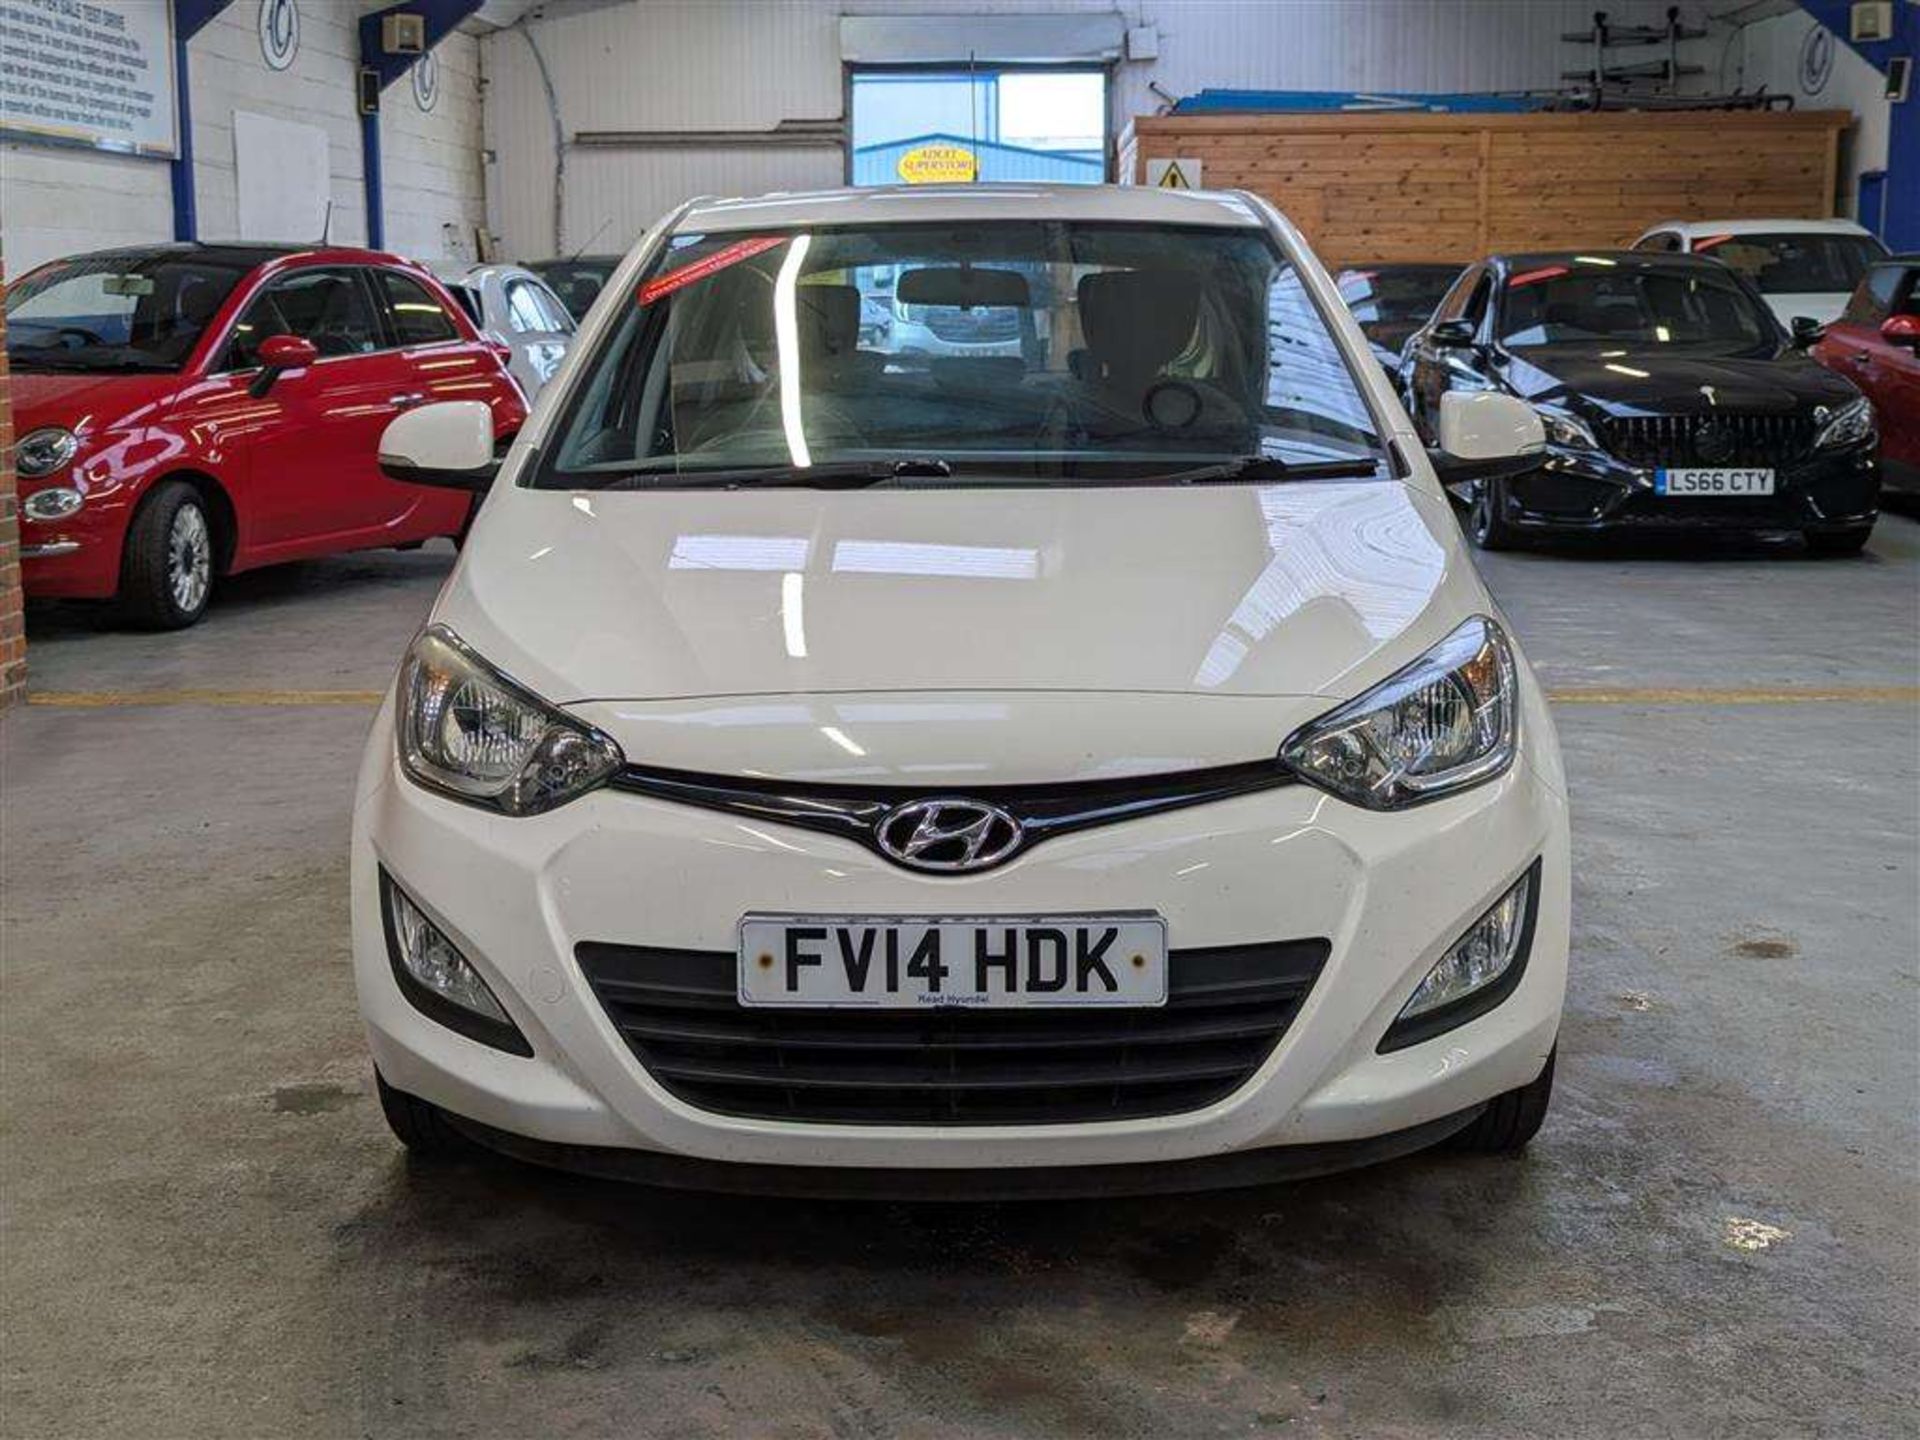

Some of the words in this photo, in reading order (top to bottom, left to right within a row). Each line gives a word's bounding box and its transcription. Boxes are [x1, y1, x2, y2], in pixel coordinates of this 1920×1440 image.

[1670, 472, 1725, 491] LS66
[1730, 472, 1767, 491] CTY
[786, 928, 949, 992] FV14
[975, 928, 1119, 992] HDK
